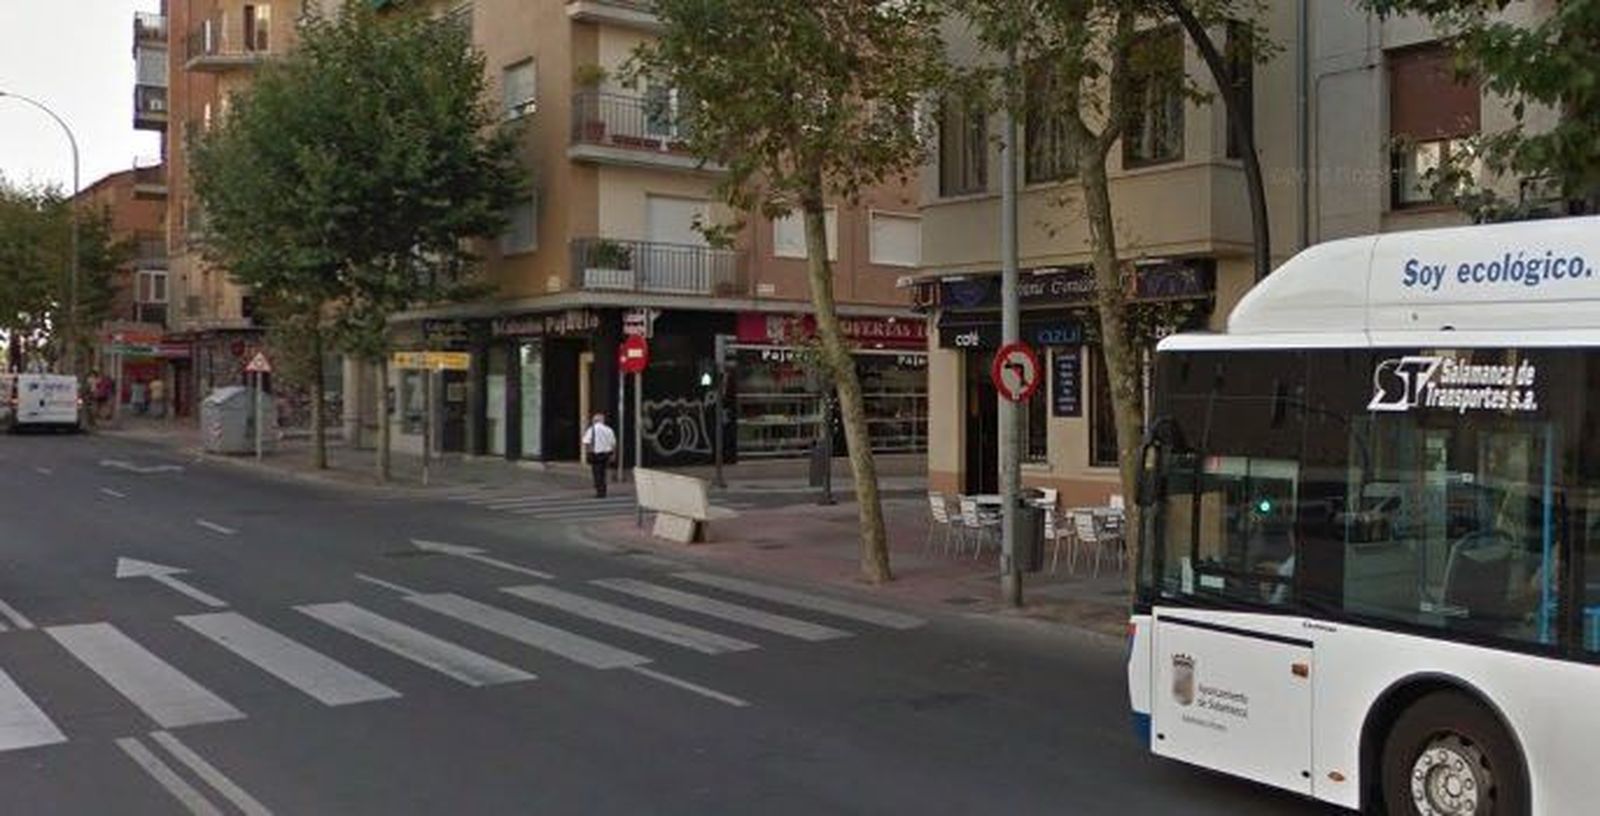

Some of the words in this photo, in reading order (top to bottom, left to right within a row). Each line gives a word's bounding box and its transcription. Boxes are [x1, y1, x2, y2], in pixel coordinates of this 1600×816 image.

[1403, 258, 1447, 290] Soy
[1457, 250, 1592, 287] ecológico.
[955, 328, 979, 347] café
[1440, 358, 1514, 386] Salamanca
[1517, 358, 1536, 386] de
[1425, 382, 1507, 414] Transportes
[1510, 389, 1538, 411] s.a.
